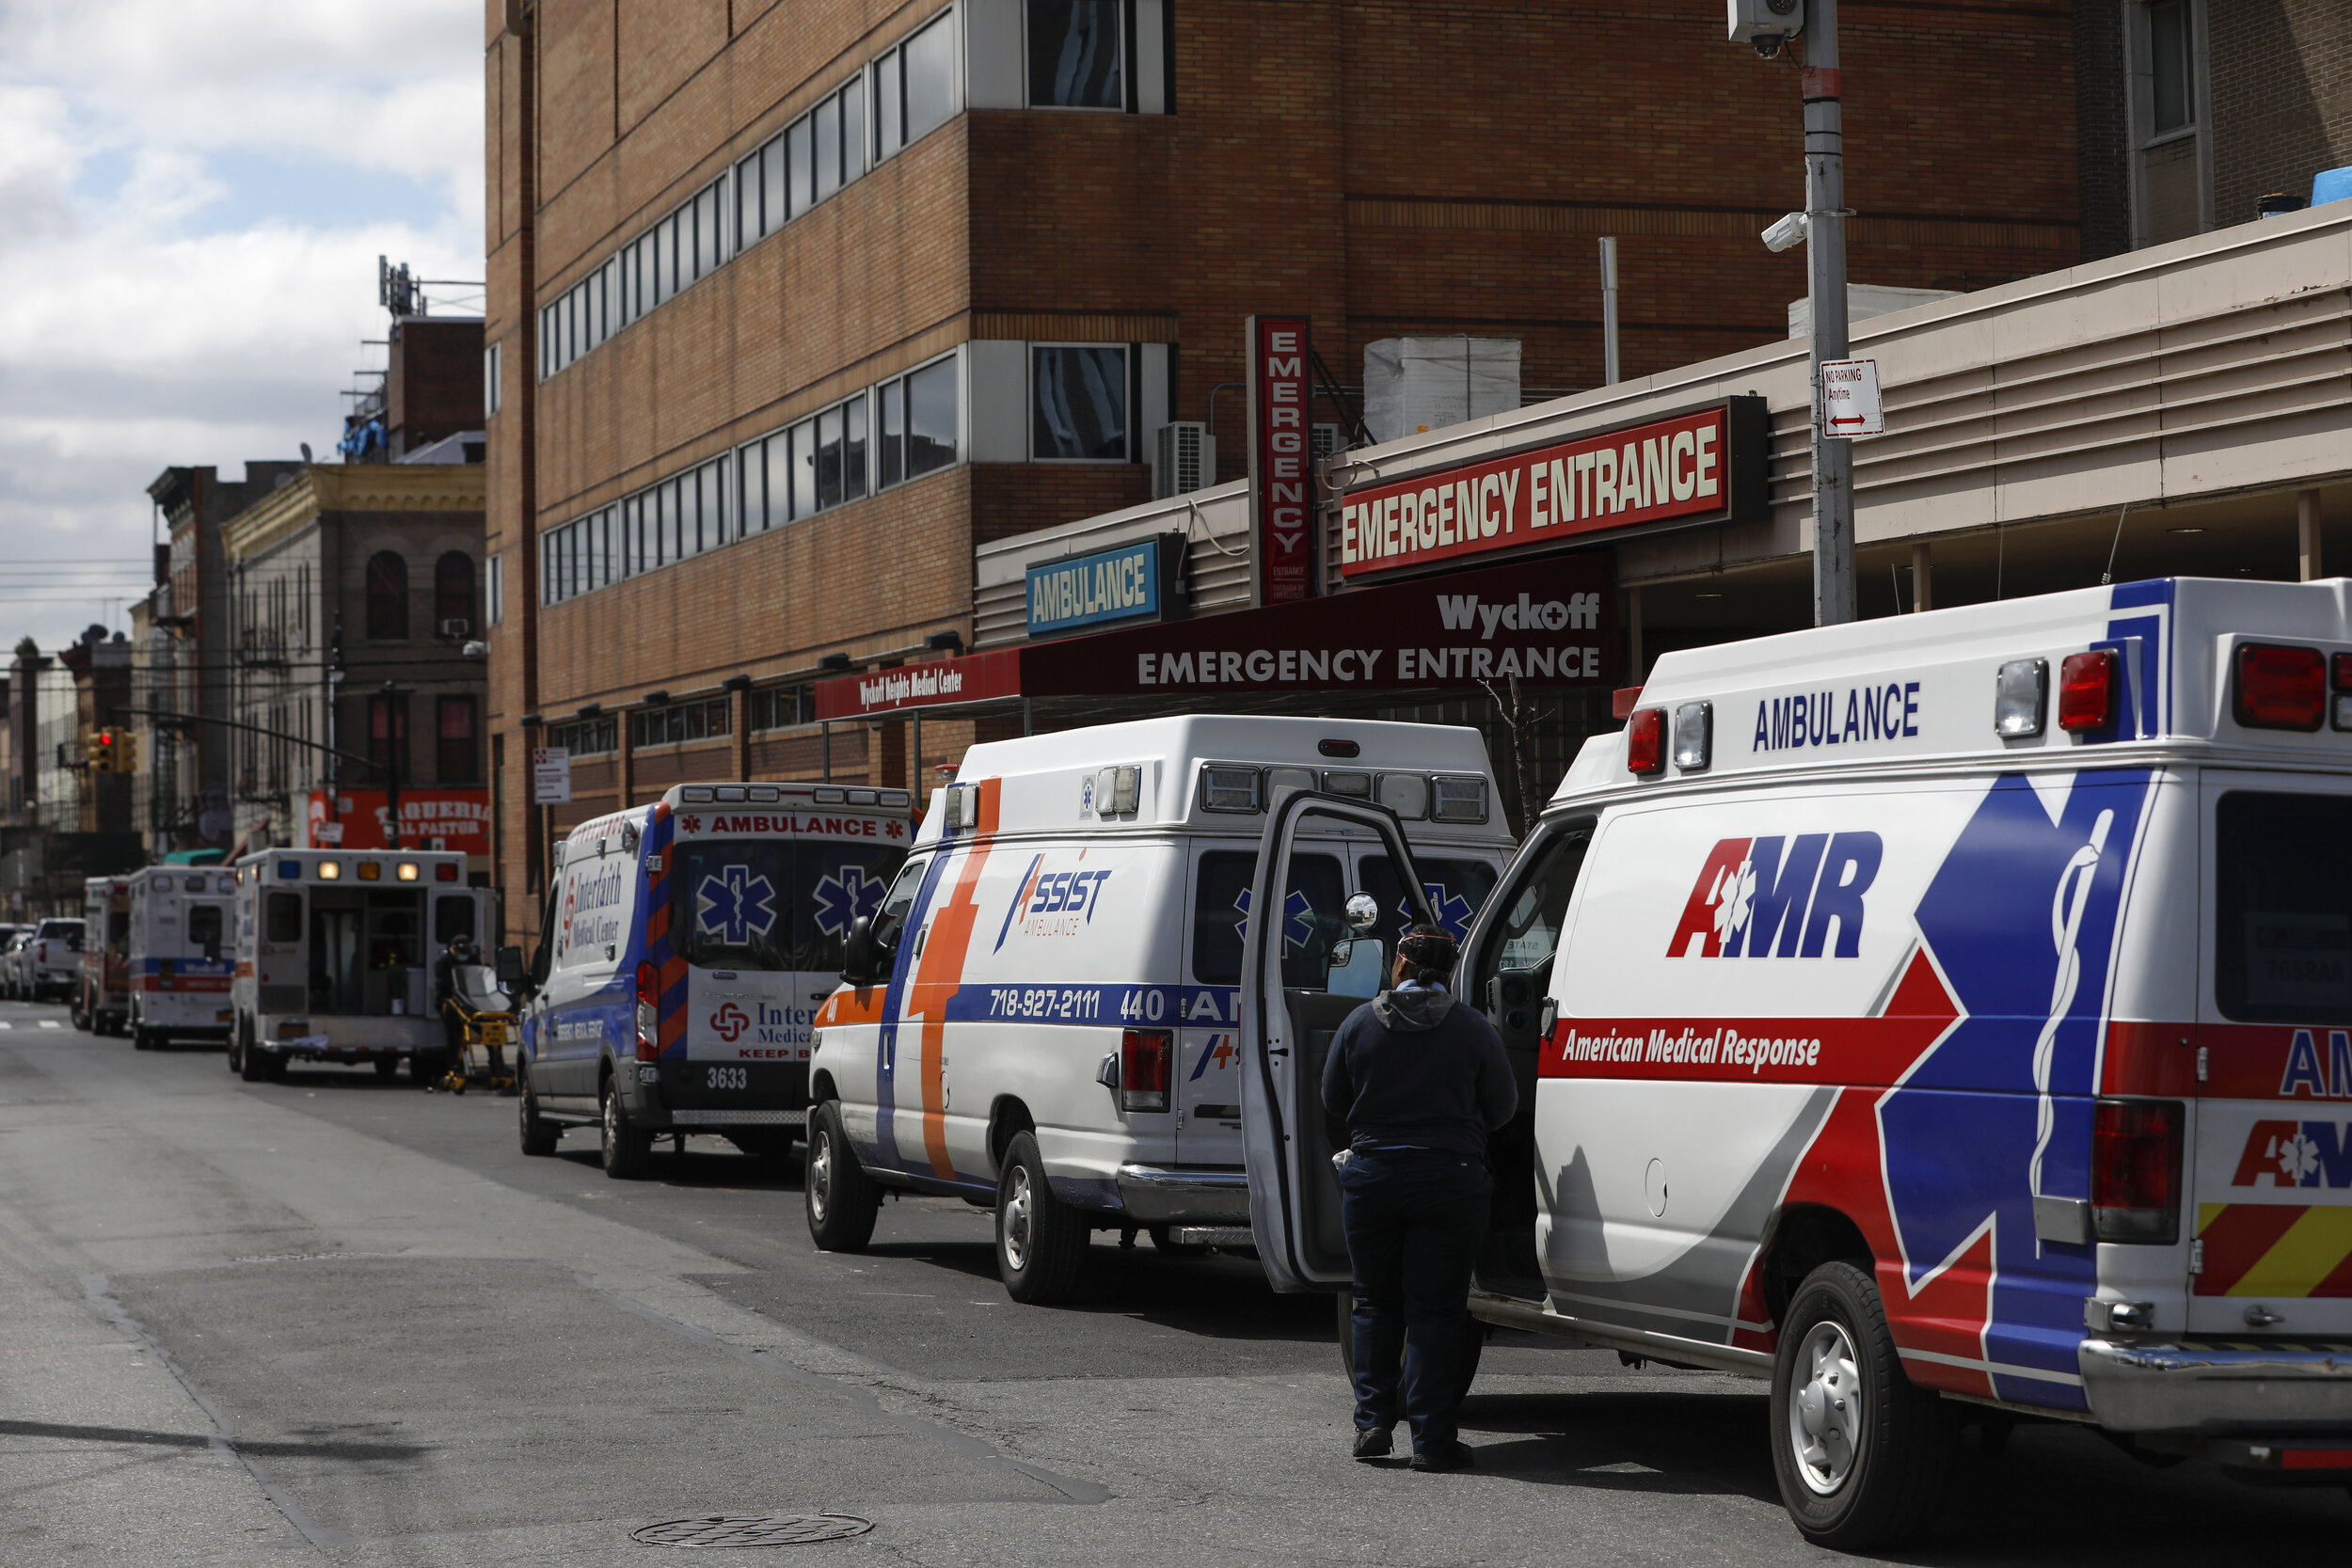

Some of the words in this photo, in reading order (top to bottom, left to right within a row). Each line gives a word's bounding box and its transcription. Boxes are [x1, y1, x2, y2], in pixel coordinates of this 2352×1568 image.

[1825, 370, 1835, 384] NO
[1835, 368, 1862, 383] PARKING
[1828, 387, 1851, 404] Anytime
[1268, 332, 1304, 553] EMERGENCY
[1342, 467, 1521, 564] EMERGENCY
[1530, 424, 1718, 529] ENTRANCE
[1032, 553, 1146, 624] AMBULANCE
[1437, 593, 1599, 639] Wyckoff
[1137, 649, 1383, 685] EMERGENCY
[1397, 646, 1599, 680] ENTRANCE
[860, 676, 884, 711] Wyckoff
[885, 673, 910, 706] Heights
[911, 668, 938, 697] Medical
[939, 668, 961, 694] Center
[1753, 681, 1920, 752] AMBULANCE
[419, 821, 480, 835] PASTOR
[710, 816, 877, 836] AMBULANCE
[574, 862, 622, 914] Interfaith
[993, 847, 1112, 956] ASSIST
[1665, 831, 1883, 958] AMR
[596, 915, 619, 943] Center
[1024, 917, 1080, 937] AMBULANCE
[990, 990, 1101, 1019] 718-927-2111
[1120, 990, 1165, 1021] 440
[739, 1049, 789, 1058] KEEP
[1562, 1027, 1645, 1062] American
[1645, 1027, 1723, 1064] Medical
[1721, 1028, 1821, 1075] Response
[707, 1067, 747, 1090] 3633
